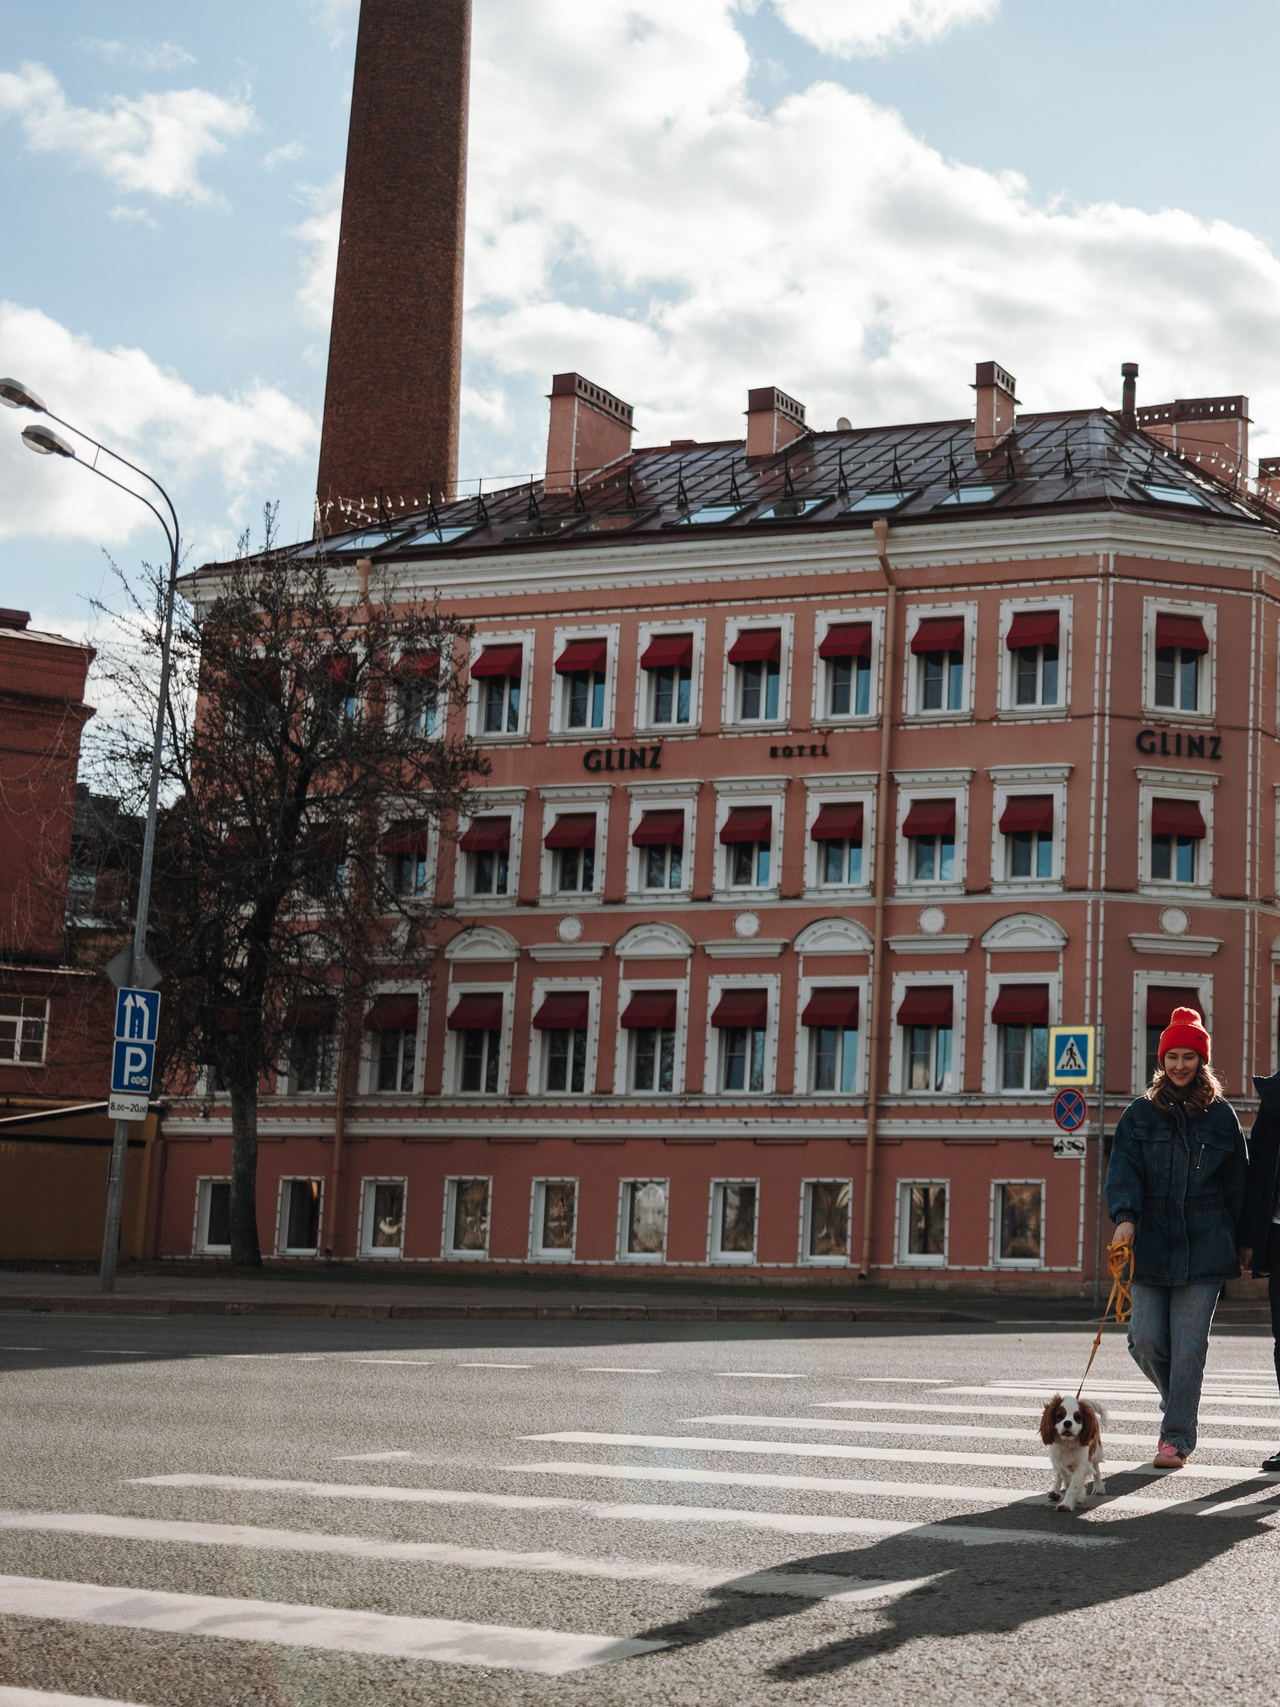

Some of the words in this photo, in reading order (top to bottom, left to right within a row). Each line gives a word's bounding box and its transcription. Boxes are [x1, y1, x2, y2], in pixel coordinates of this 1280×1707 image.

[583, 746, 662, 772] GLINZ
[1136, 730, 1222, 760] GLINZ
[123, 1046, 147, 1086] P
